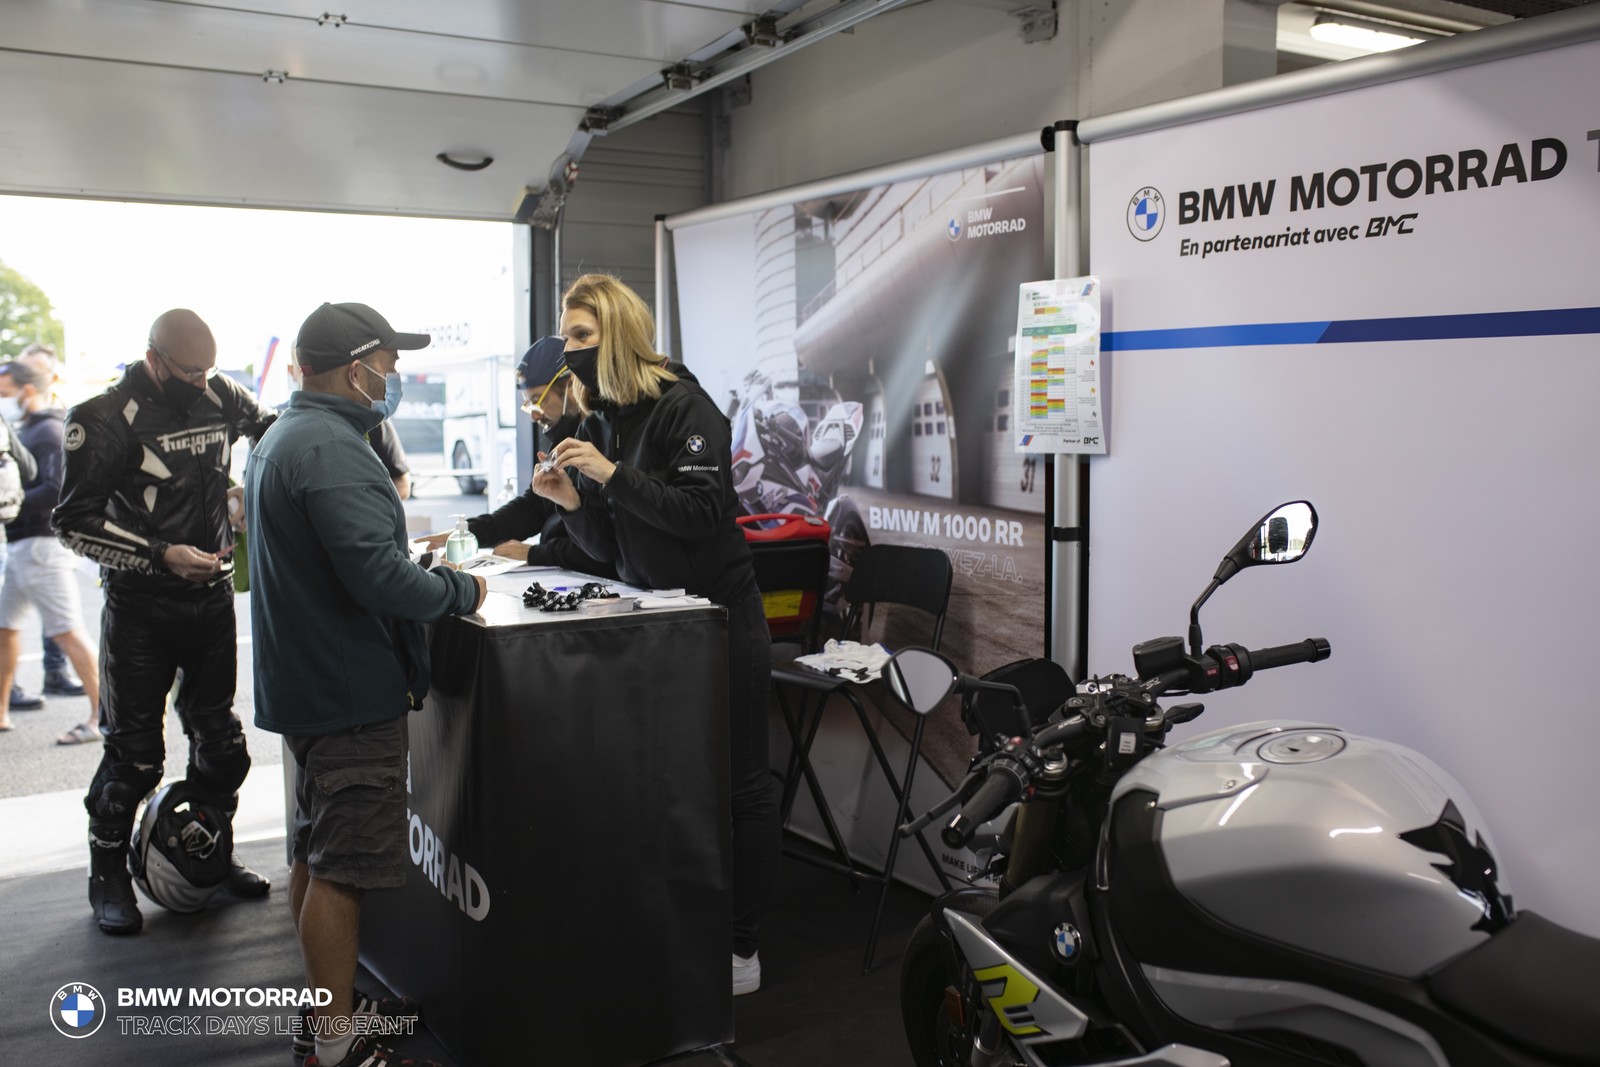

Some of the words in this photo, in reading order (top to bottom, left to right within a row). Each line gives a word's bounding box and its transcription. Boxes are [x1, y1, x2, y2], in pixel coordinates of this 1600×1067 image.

[1178, 179, 1276, 225] BMW
[1290, 137, 1568, 212] MOTORRAD
[967, 207, 993, 223] BMW
[967, 218, 1026, 239] MOTORRAD
[1179, 238, 1199, 257] En
[1201, 227, 1310, 259] partenariat
[1314, 225, 1360, 244] avec
[1365, 213, 1419, 238] BMC
[869, 506, 920, 533] BMW
[923, 512, 940, 536] M
[943, 514, 991, 542] 1000
[995, 519, 1024, 547] RR
[407, 808, 491, 922] ORRAD
[941, 853, 966, 871] MAKE
